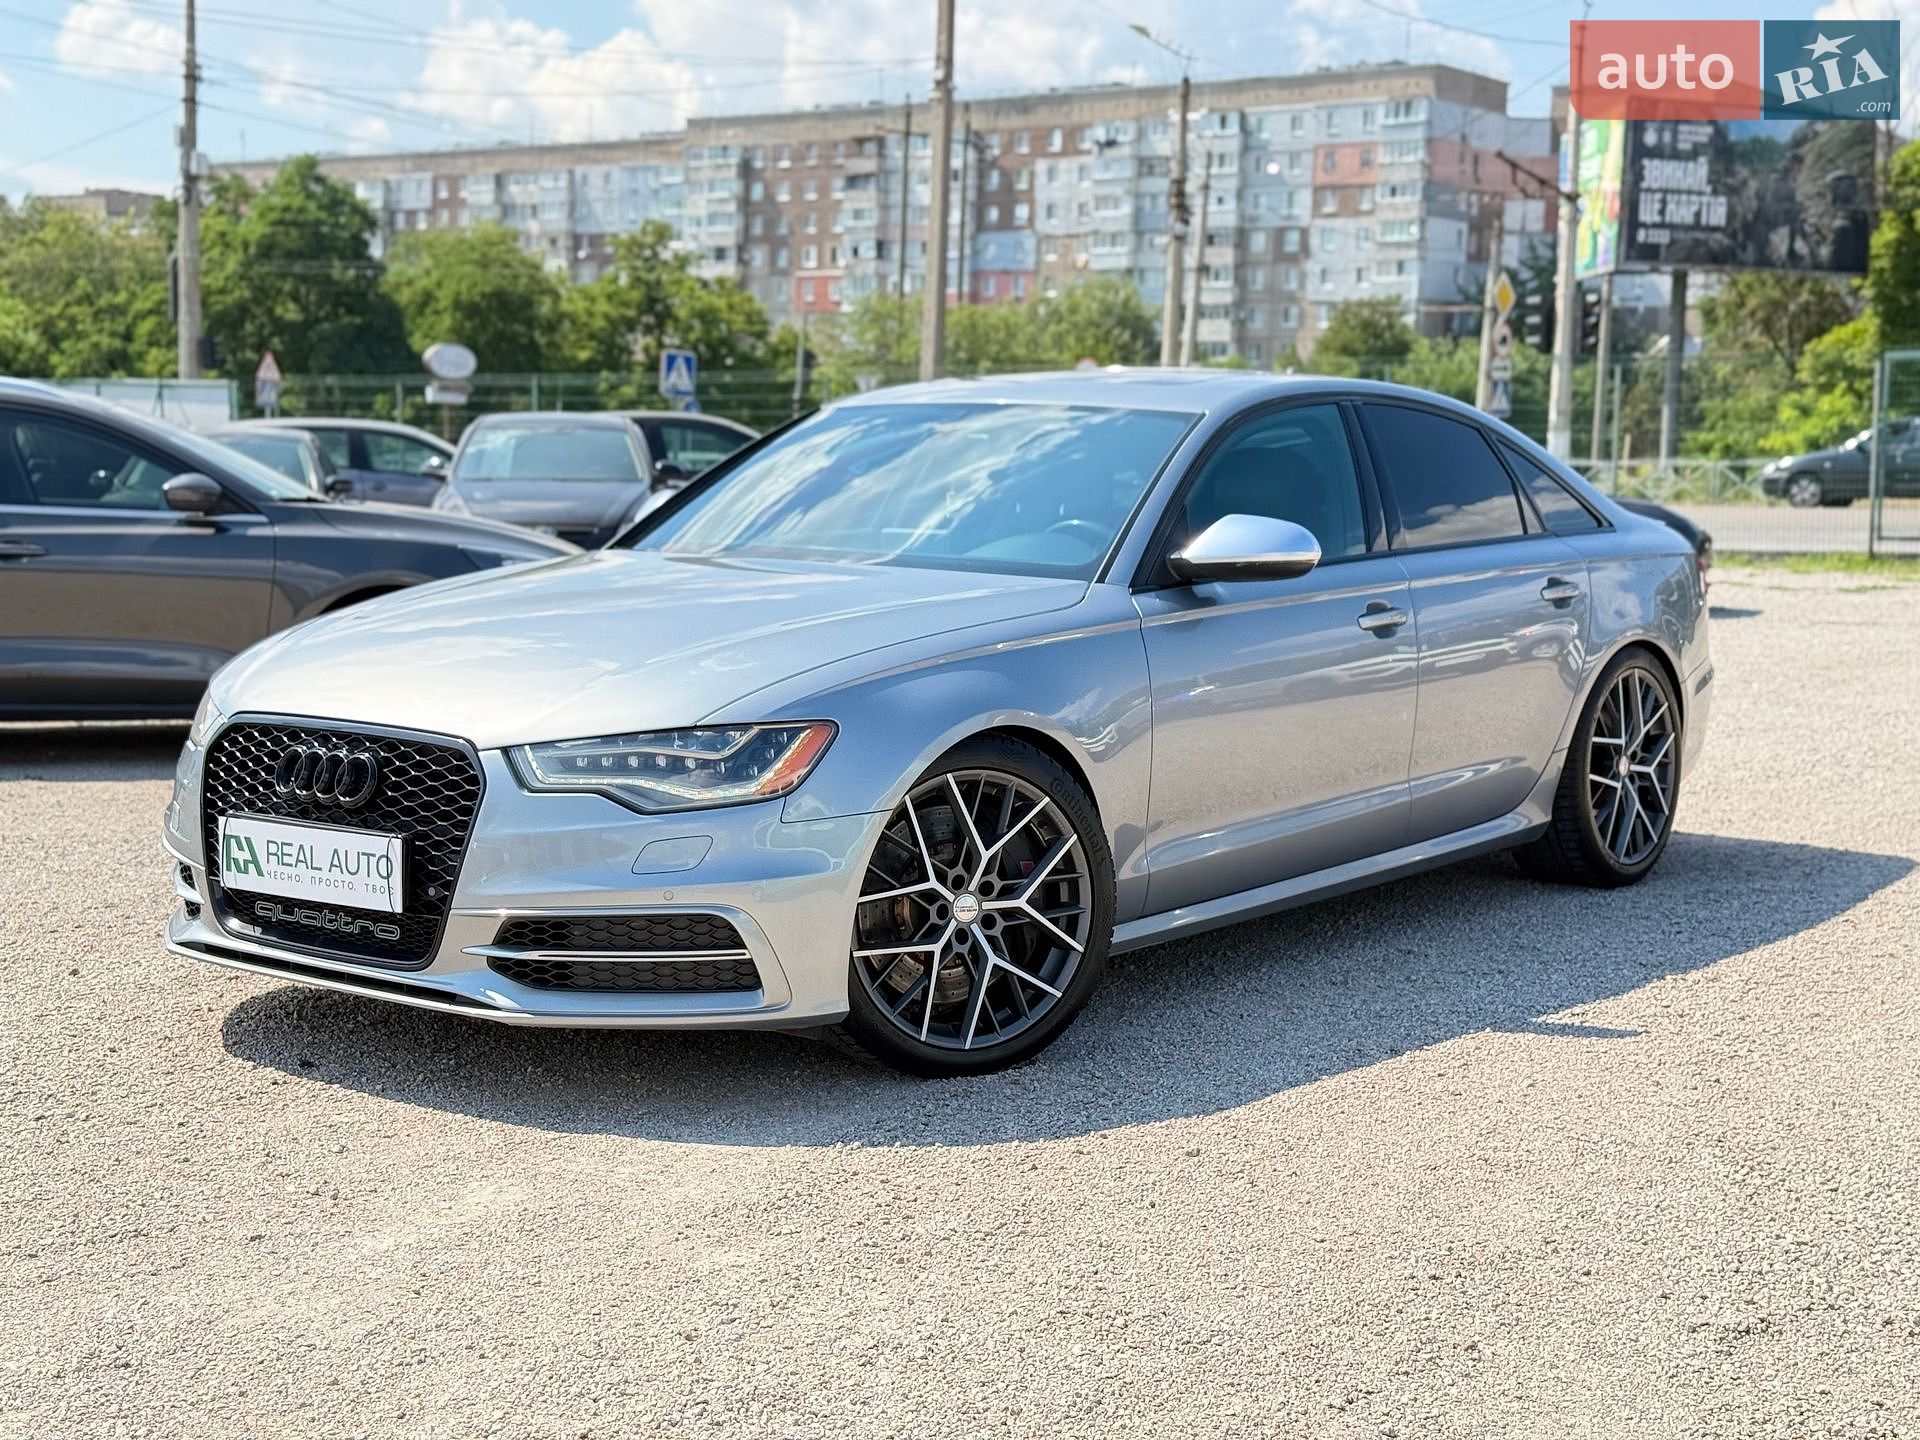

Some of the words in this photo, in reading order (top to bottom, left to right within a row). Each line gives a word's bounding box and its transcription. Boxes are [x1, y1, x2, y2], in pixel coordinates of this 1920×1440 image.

[266, 839, 323, 872] REAL
[328, 848, 394, 881] AUTO
[255, 901, 400, 940] quattro
